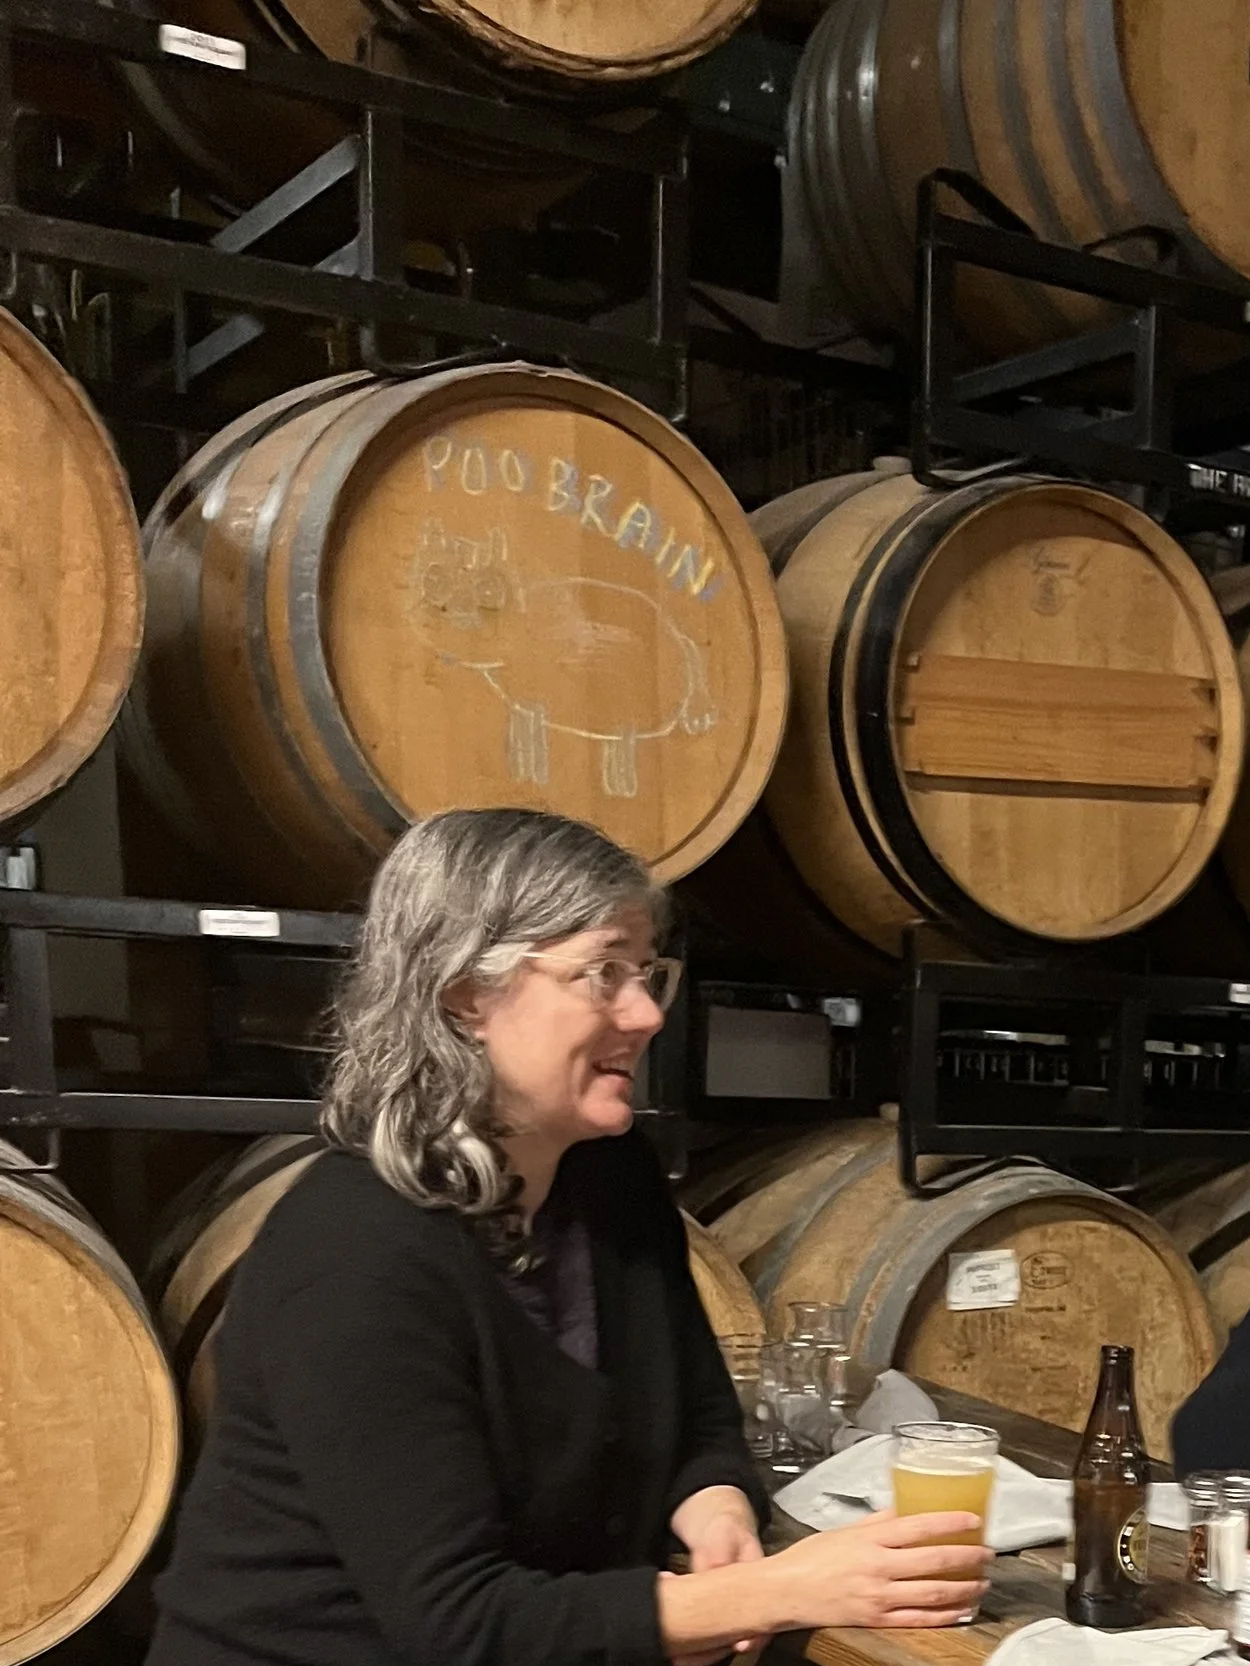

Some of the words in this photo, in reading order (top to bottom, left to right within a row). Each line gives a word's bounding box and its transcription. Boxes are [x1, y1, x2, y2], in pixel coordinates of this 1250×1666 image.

[421, 436, 530, 497] POO
[546, 457, 720, 598] BRAIN
[1186, 463, 1228, 494] THE
